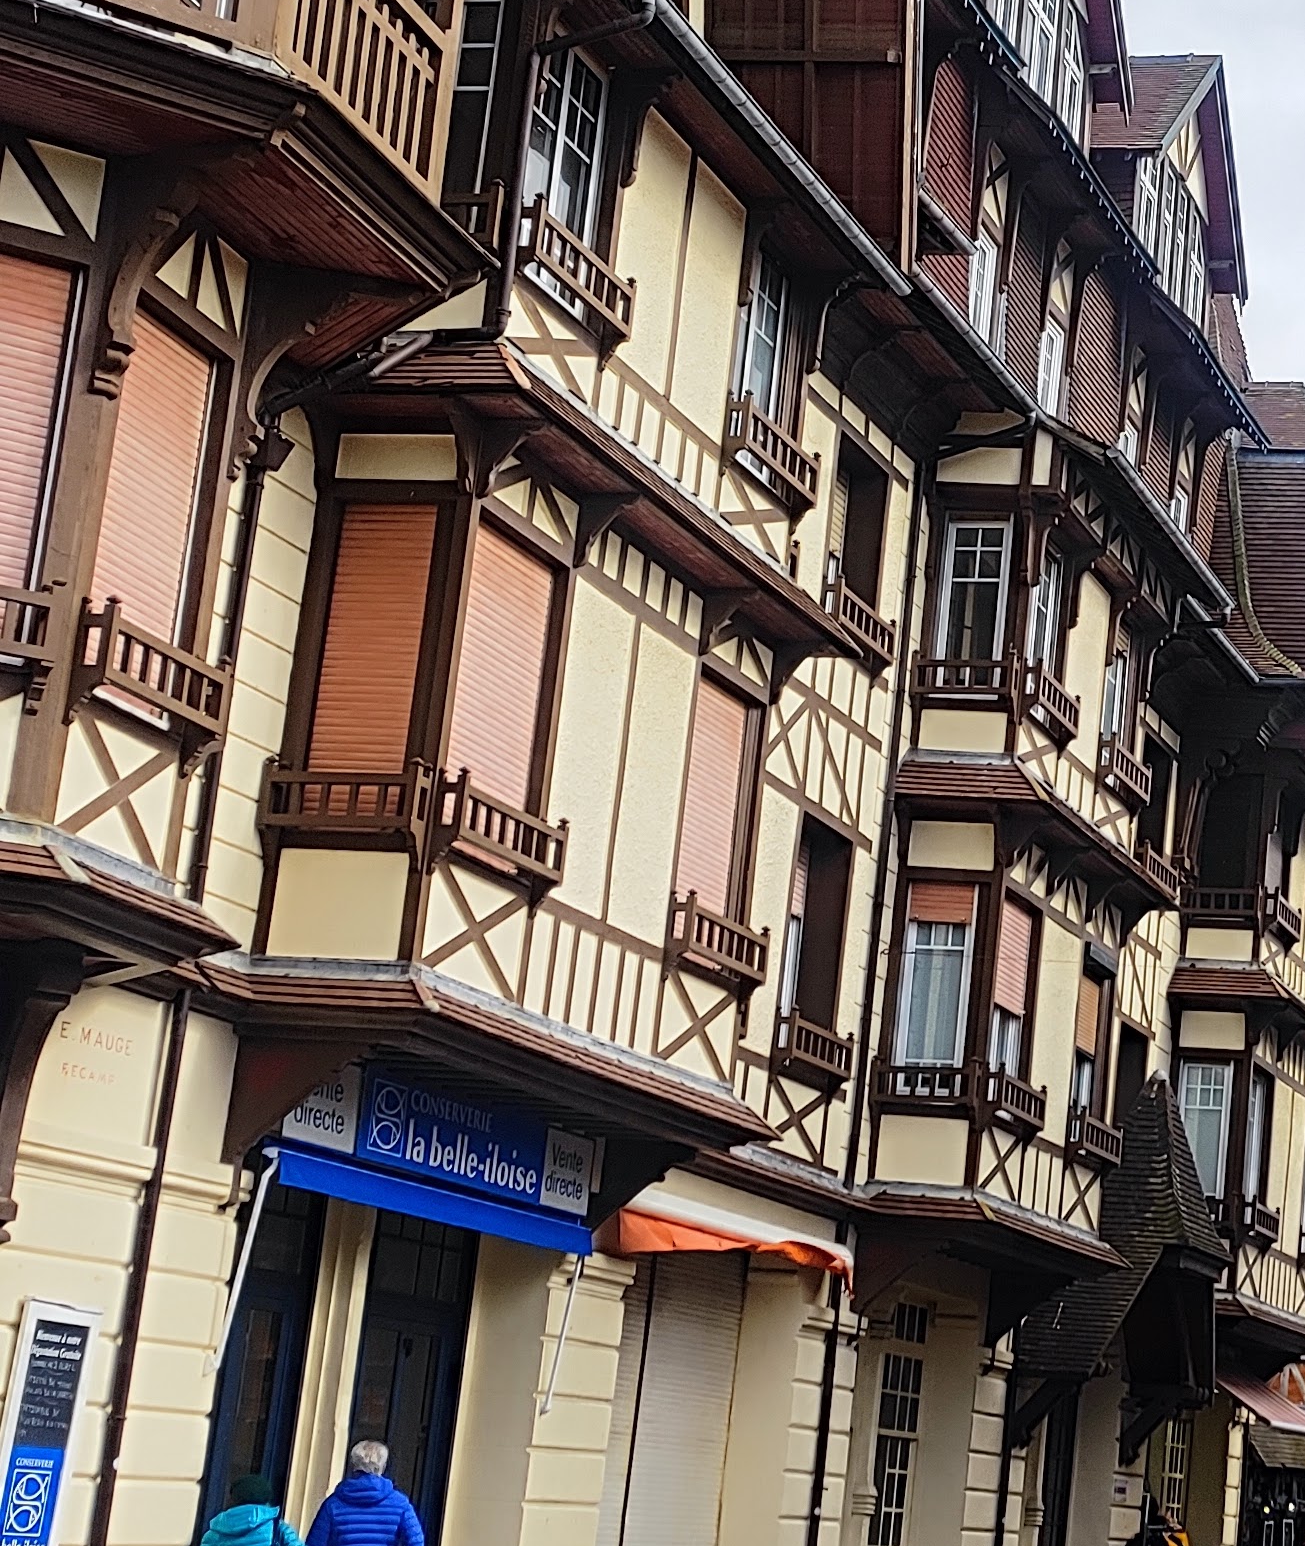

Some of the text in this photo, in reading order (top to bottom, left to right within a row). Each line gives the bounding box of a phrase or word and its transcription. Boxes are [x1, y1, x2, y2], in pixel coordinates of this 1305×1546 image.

[294, 1100, 344, 1134] directe
[411, 1090, 493, 1133] CONSERVERIE
[406, 1118, 537, 1194] la belle-iloise
[552, 1141, 583, 1174] Vente
[545, 1170, 583, 1200] directe
